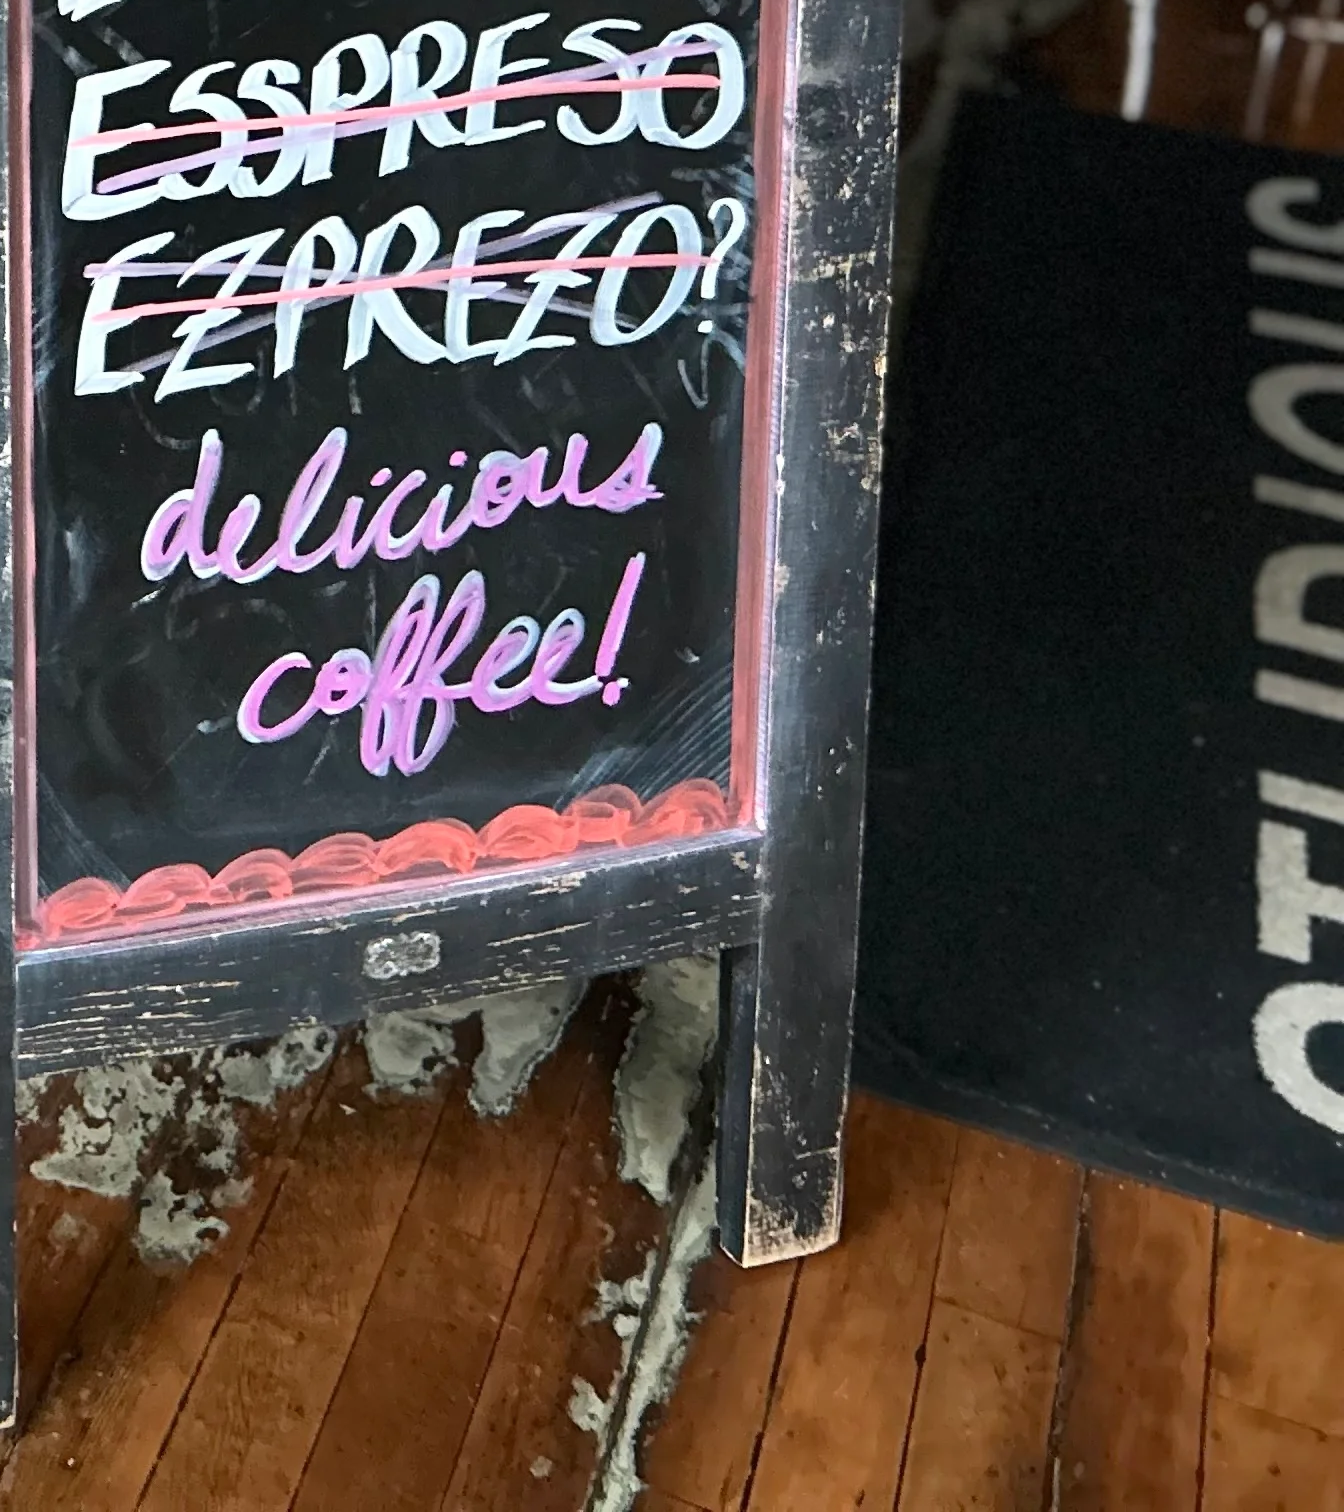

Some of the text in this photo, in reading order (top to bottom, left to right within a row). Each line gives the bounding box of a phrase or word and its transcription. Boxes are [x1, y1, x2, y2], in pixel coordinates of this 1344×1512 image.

[61, 10, 748, 221] ESSPRESO
[73, 197, 748, 404] EZPREZO?
[139, 421, 666, 585] delicious
[235, 550, 647, 777] coffee!
